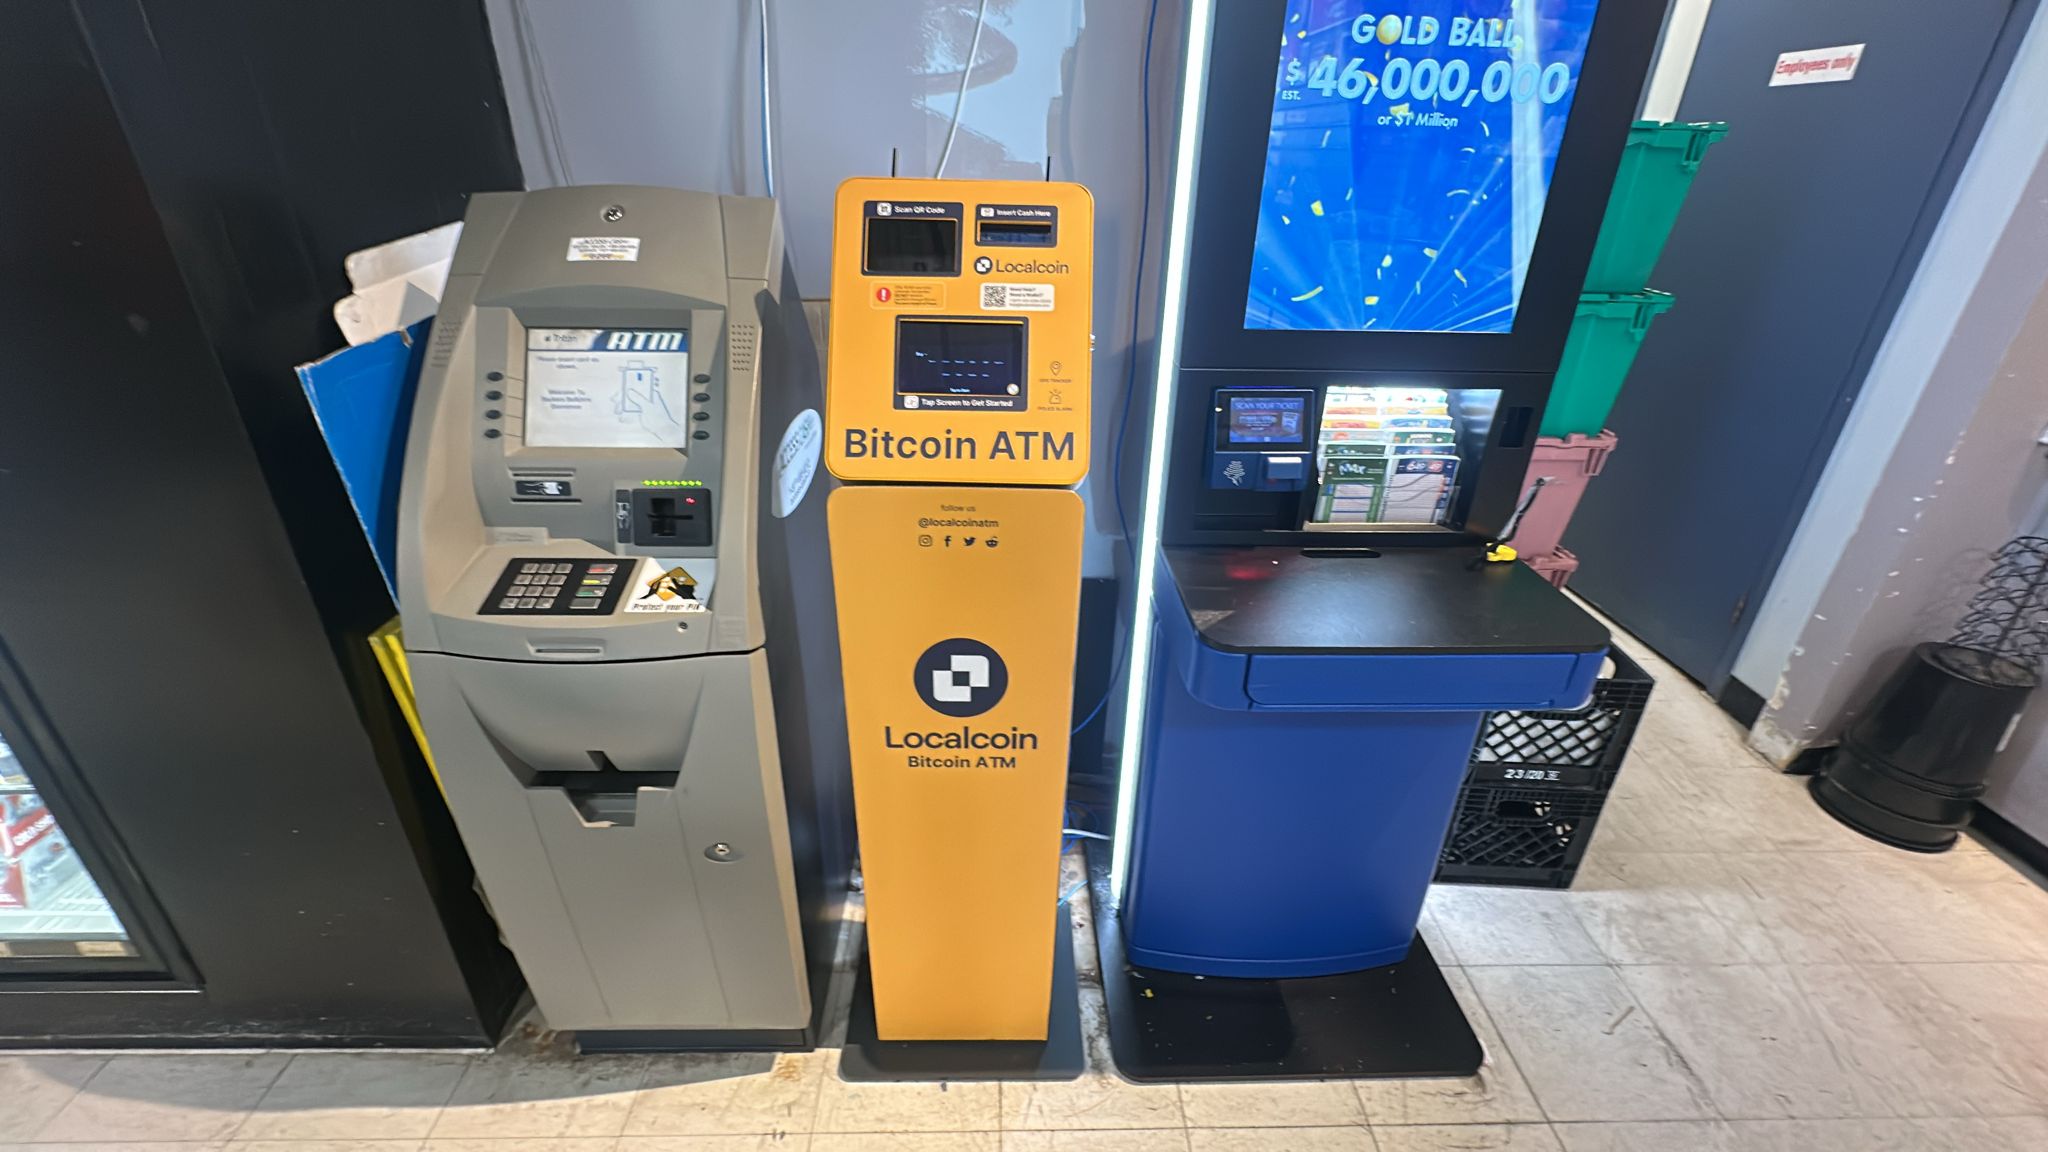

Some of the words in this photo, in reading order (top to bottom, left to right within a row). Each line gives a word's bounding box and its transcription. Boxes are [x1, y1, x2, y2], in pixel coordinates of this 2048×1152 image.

[1351, 14, 1439, 45] GOLD
[1449, 17, 1519, 48] BALL
[1776, 59, 1830, 75] Employees
[1831, 54, 1857, 71] only
[1285, 58, 1301, 86] $
[1307, 55, 1570, 108] 46,000,000
[1281, 89, 1301, 101] EST.
[1377, 114, 1392, 126] or
[1415, 111, 1459, 130] Million
[894, 205, 913, 214] Scan
[913, 206, 925, 214] QR
[925, 206, 946, 215] Code
[996, 209, 1017, 217] Insert
[1017, 209, 1034, 217] Cash
[1034, 209, 1052, 217] Here
[995, 259, 1070, 275] Localcoin
[606, 331, 683, 351] ATM
[921, 398, 935, 406] Tap
[935, 398, 962, 406] Screen
[985, 399, 1013, 407] Started
[845, 428, 976, 459] Bitcoin
[989, 431, 1074, 461] ATM
[940, 504, 964, 512] follow
[918, 518, 999, 529] @localcoinatm
[632, 603, 664, 611] Protect
[884, 726, 1038, 750] Localcoin
[908, 755, 970, 768] Bitcoin
[975, 756, 1016, 768] ATM
